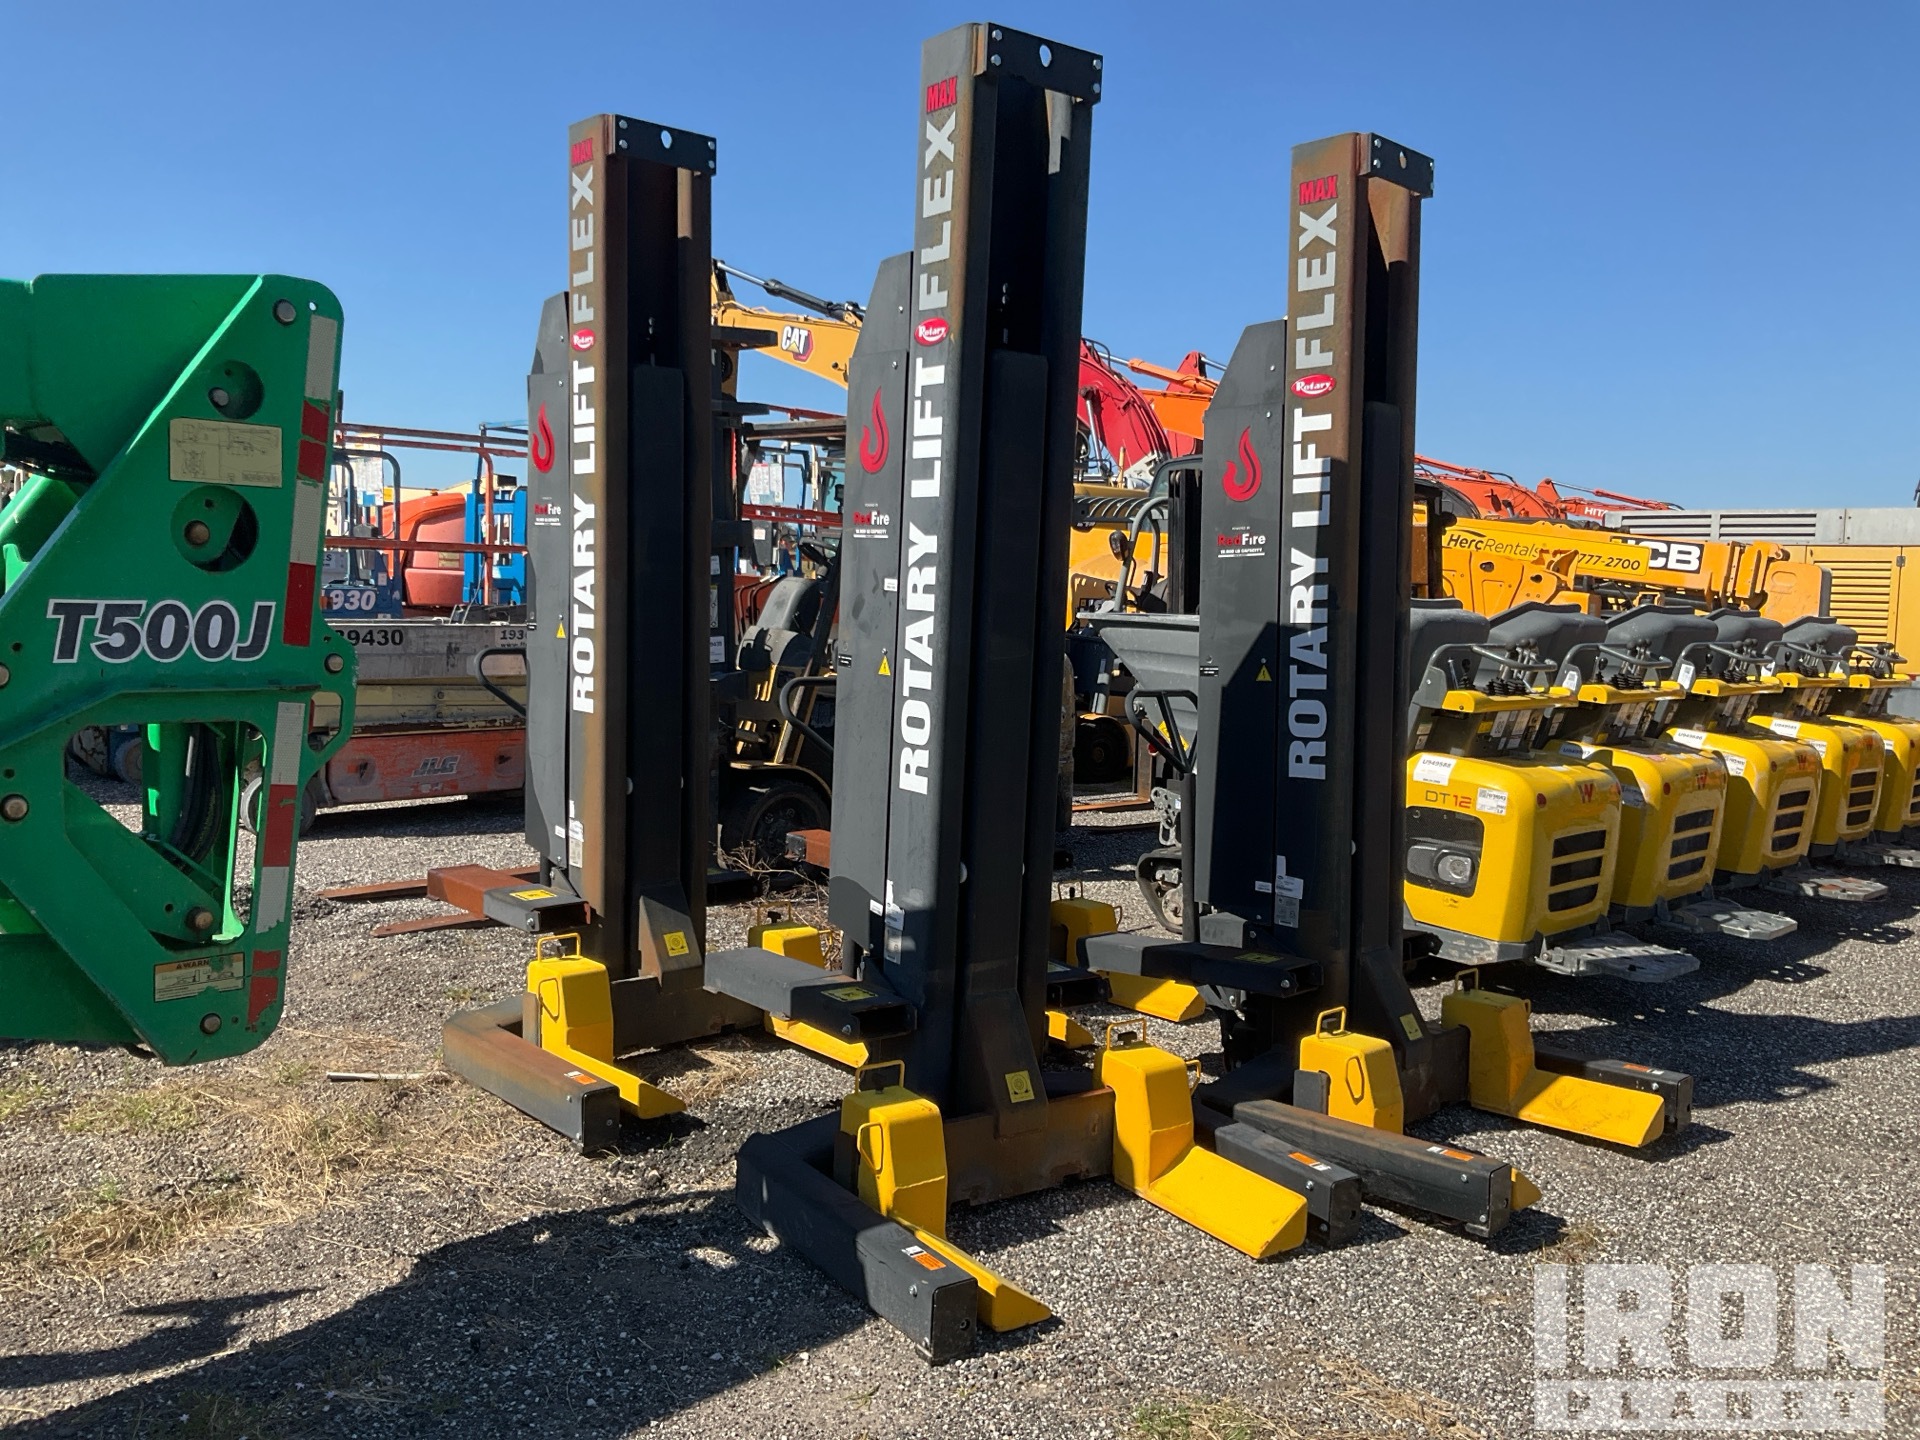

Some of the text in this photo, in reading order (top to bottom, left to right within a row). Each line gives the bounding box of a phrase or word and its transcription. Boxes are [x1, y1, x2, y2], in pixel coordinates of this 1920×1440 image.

[926, 76, 958, 114] MAX
[571, 137, 594, 168] MAX
[1299, 174, 1339, 206] MAX
[919, 110, 956, 311] FLEX
[572, 165, 594, 325] FLEX
[1295, 203, 1338, 370] FLEX
[782, 325, 809, 355] CAT
[1295, 381, 1331, 394] Rotary
[853, 510, 890, 526] RedFire
[572, 360, 595, 714] ROTARY LIFT
[1217, 533, 1266, 546] RedFire
[1621, 538, 1700, 571] CB
[899, 356, 946, 795] ROTARY LIFT
[1288, 407, 1332, 781] ROTARY LIFT
[47, 599, 276, 663] T500J
[411, 755, 461, 777] JLG
